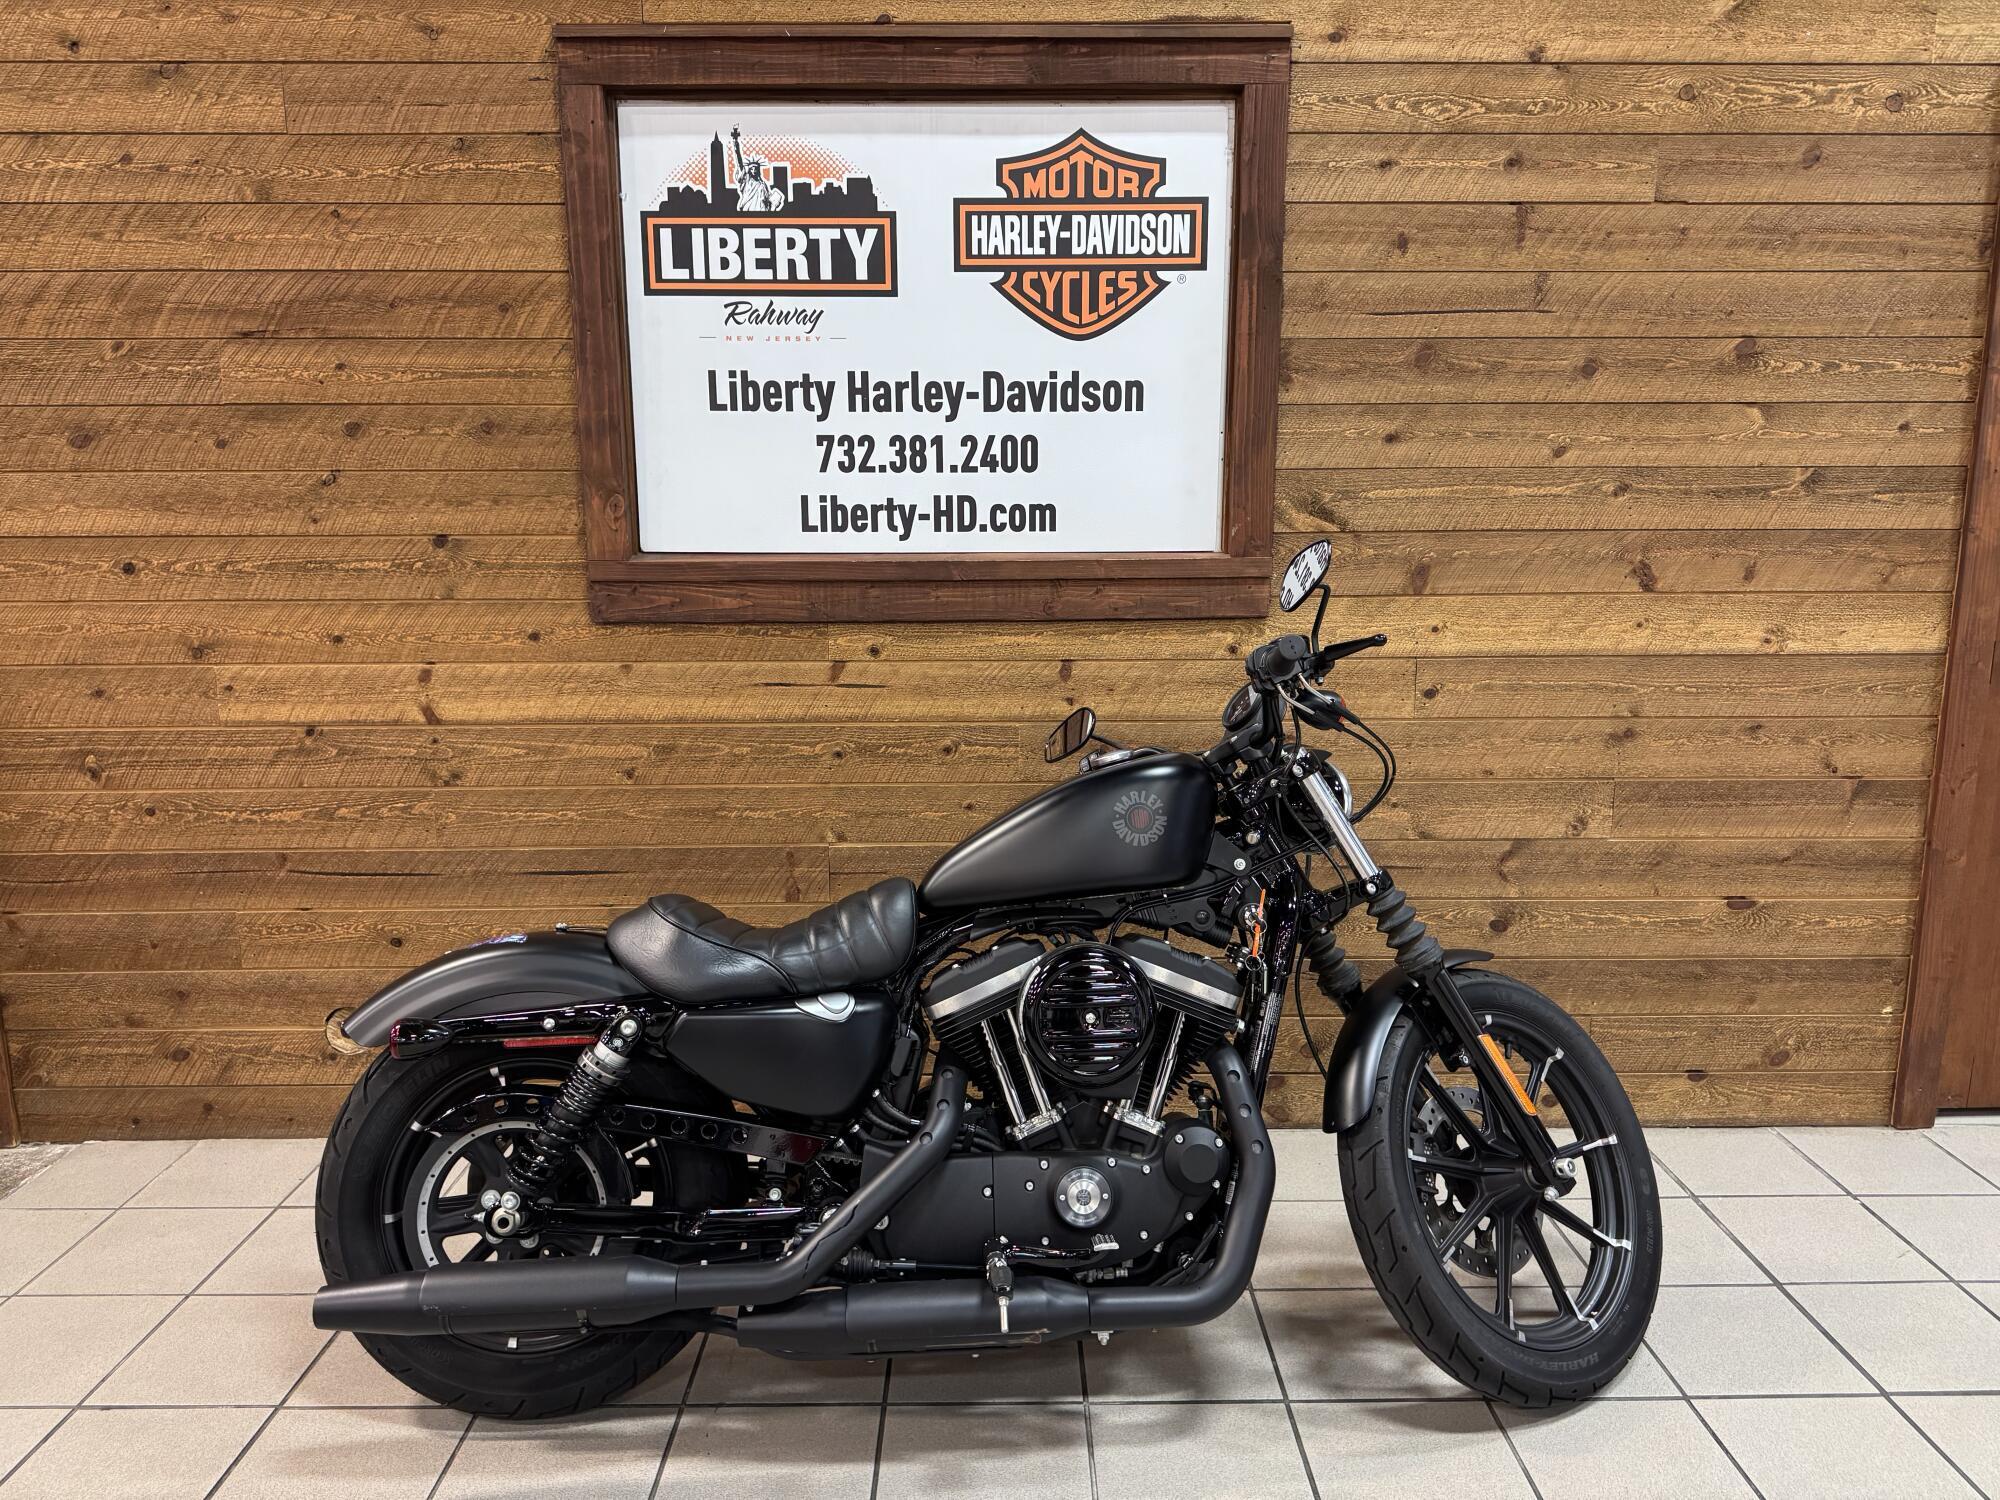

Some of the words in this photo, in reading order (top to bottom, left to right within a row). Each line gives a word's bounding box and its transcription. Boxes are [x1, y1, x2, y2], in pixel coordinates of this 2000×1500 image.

[1023, 149, 1140, 198] MOTOR
[658, 227, 879, 281] LIBERTY
[971, 212, 1191, 256] HARLEY-DAVIDSON
[723, 299, 825, 334] Rahway
[1022, 270, 1138, 325] CYCLES
[707, 369, 836, 422] Liberty
[846, 370, 1145, 423] Harley-Davidson
[815, 434, 1039, 474] 732.381.2400
[800, 495, 1057, 542] Liberty-HD.com
[1113, 790, 1164, 815] HARLEY
[1111, 815, 1168, 847] DAVIDSON
